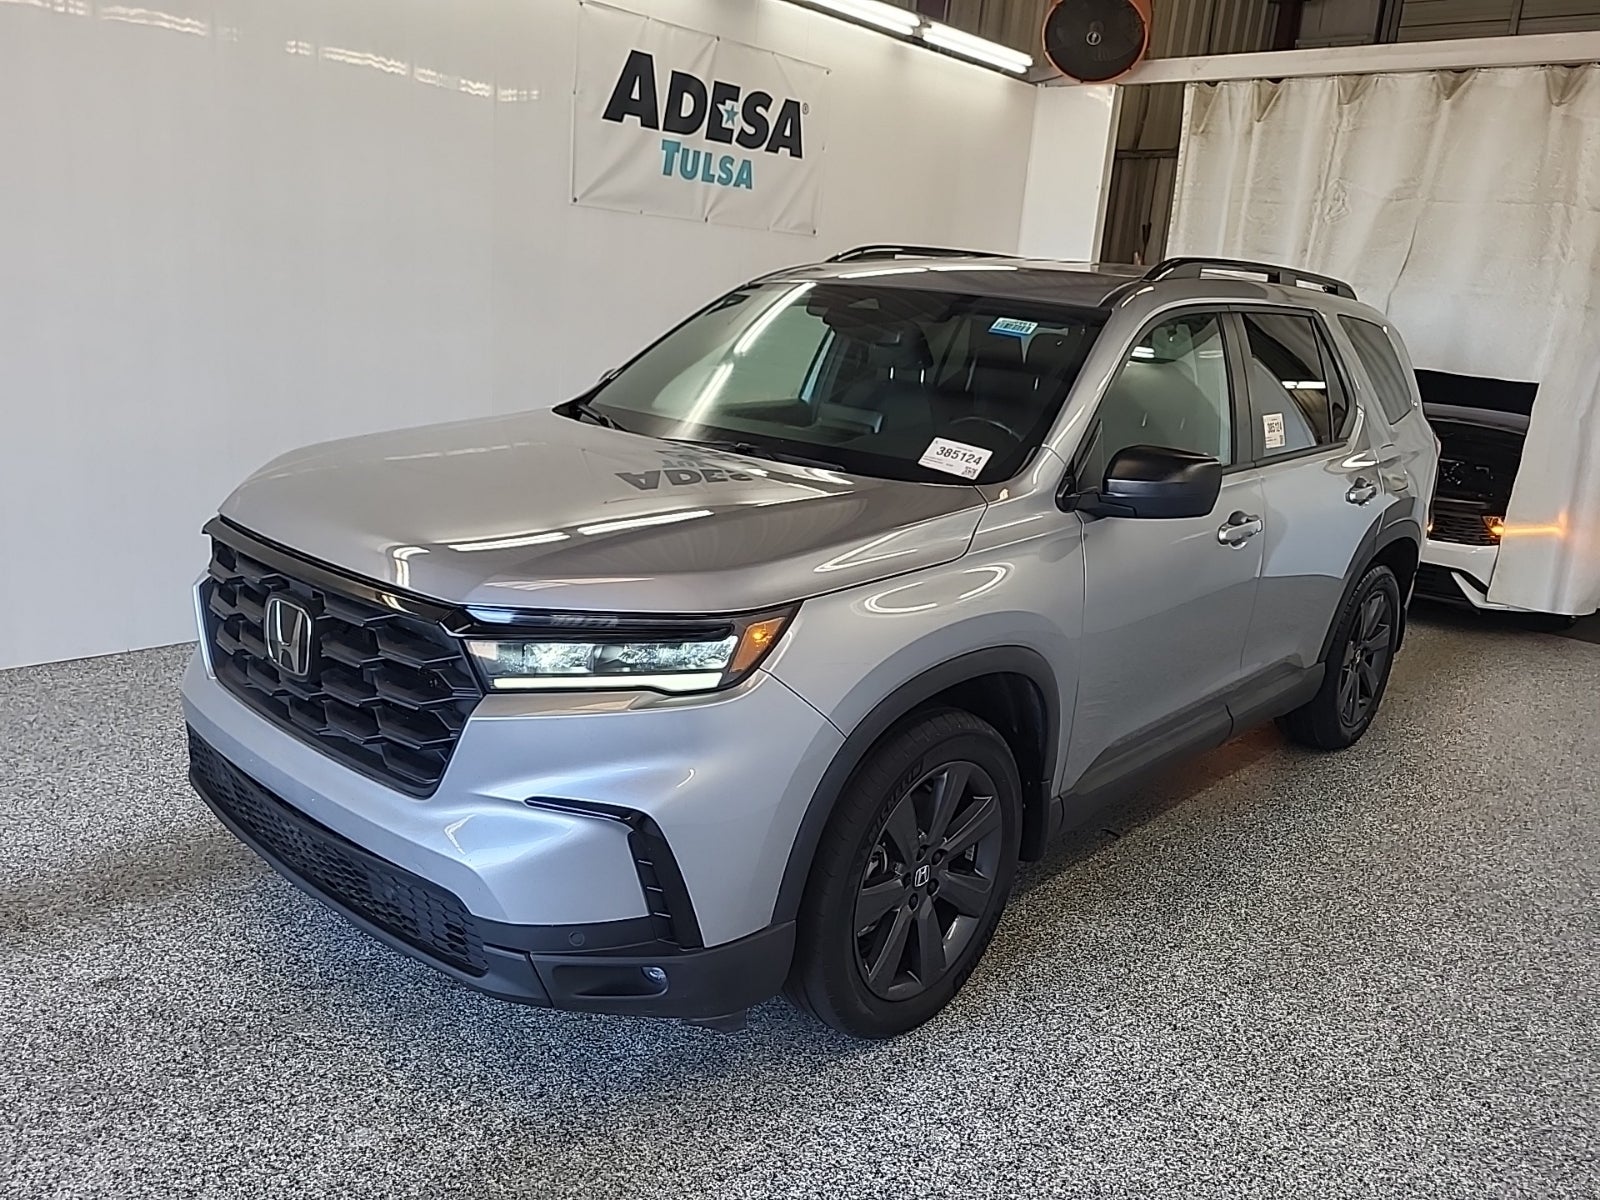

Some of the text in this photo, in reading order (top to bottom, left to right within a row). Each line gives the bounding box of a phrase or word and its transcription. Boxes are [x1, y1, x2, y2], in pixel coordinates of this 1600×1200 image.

[602, 50, 803, 159] ADESA
[661, 139, 753, 190] TULSA
[936, 446, 983, 466] 385124
